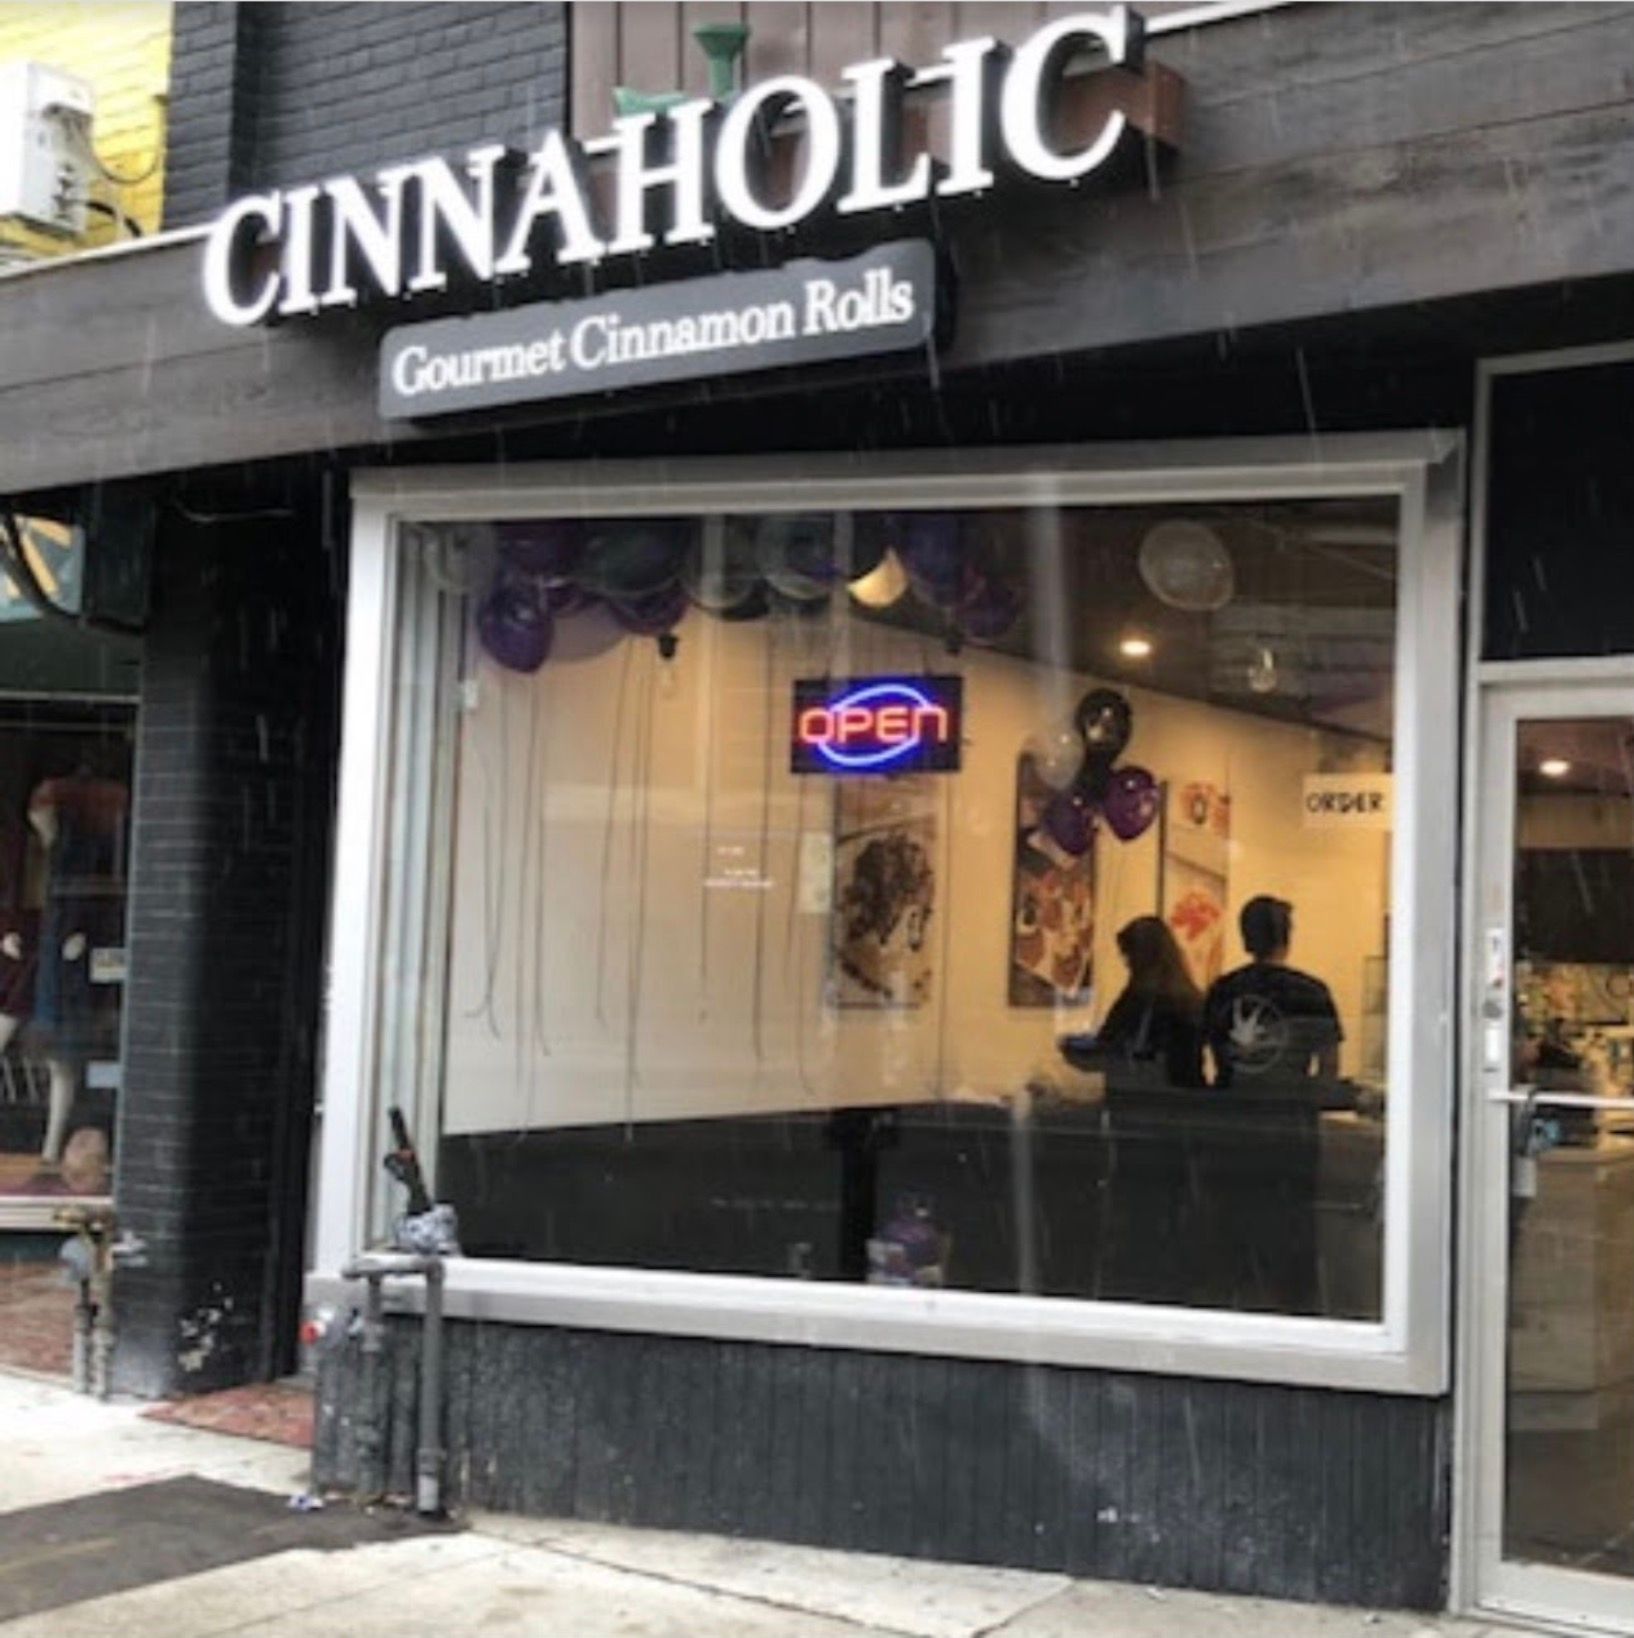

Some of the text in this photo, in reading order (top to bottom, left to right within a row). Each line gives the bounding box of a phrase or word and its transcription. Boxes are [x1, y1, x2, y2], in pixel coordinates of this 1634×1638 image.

[203, 4, 1130, 327] CINNAHOLIC
[391, 266, 914, 396] Gourmet Cinnamon Rolls
[797, 705, 948, 744] OPEN
[1306, 792, 1383, 814] ORDER
